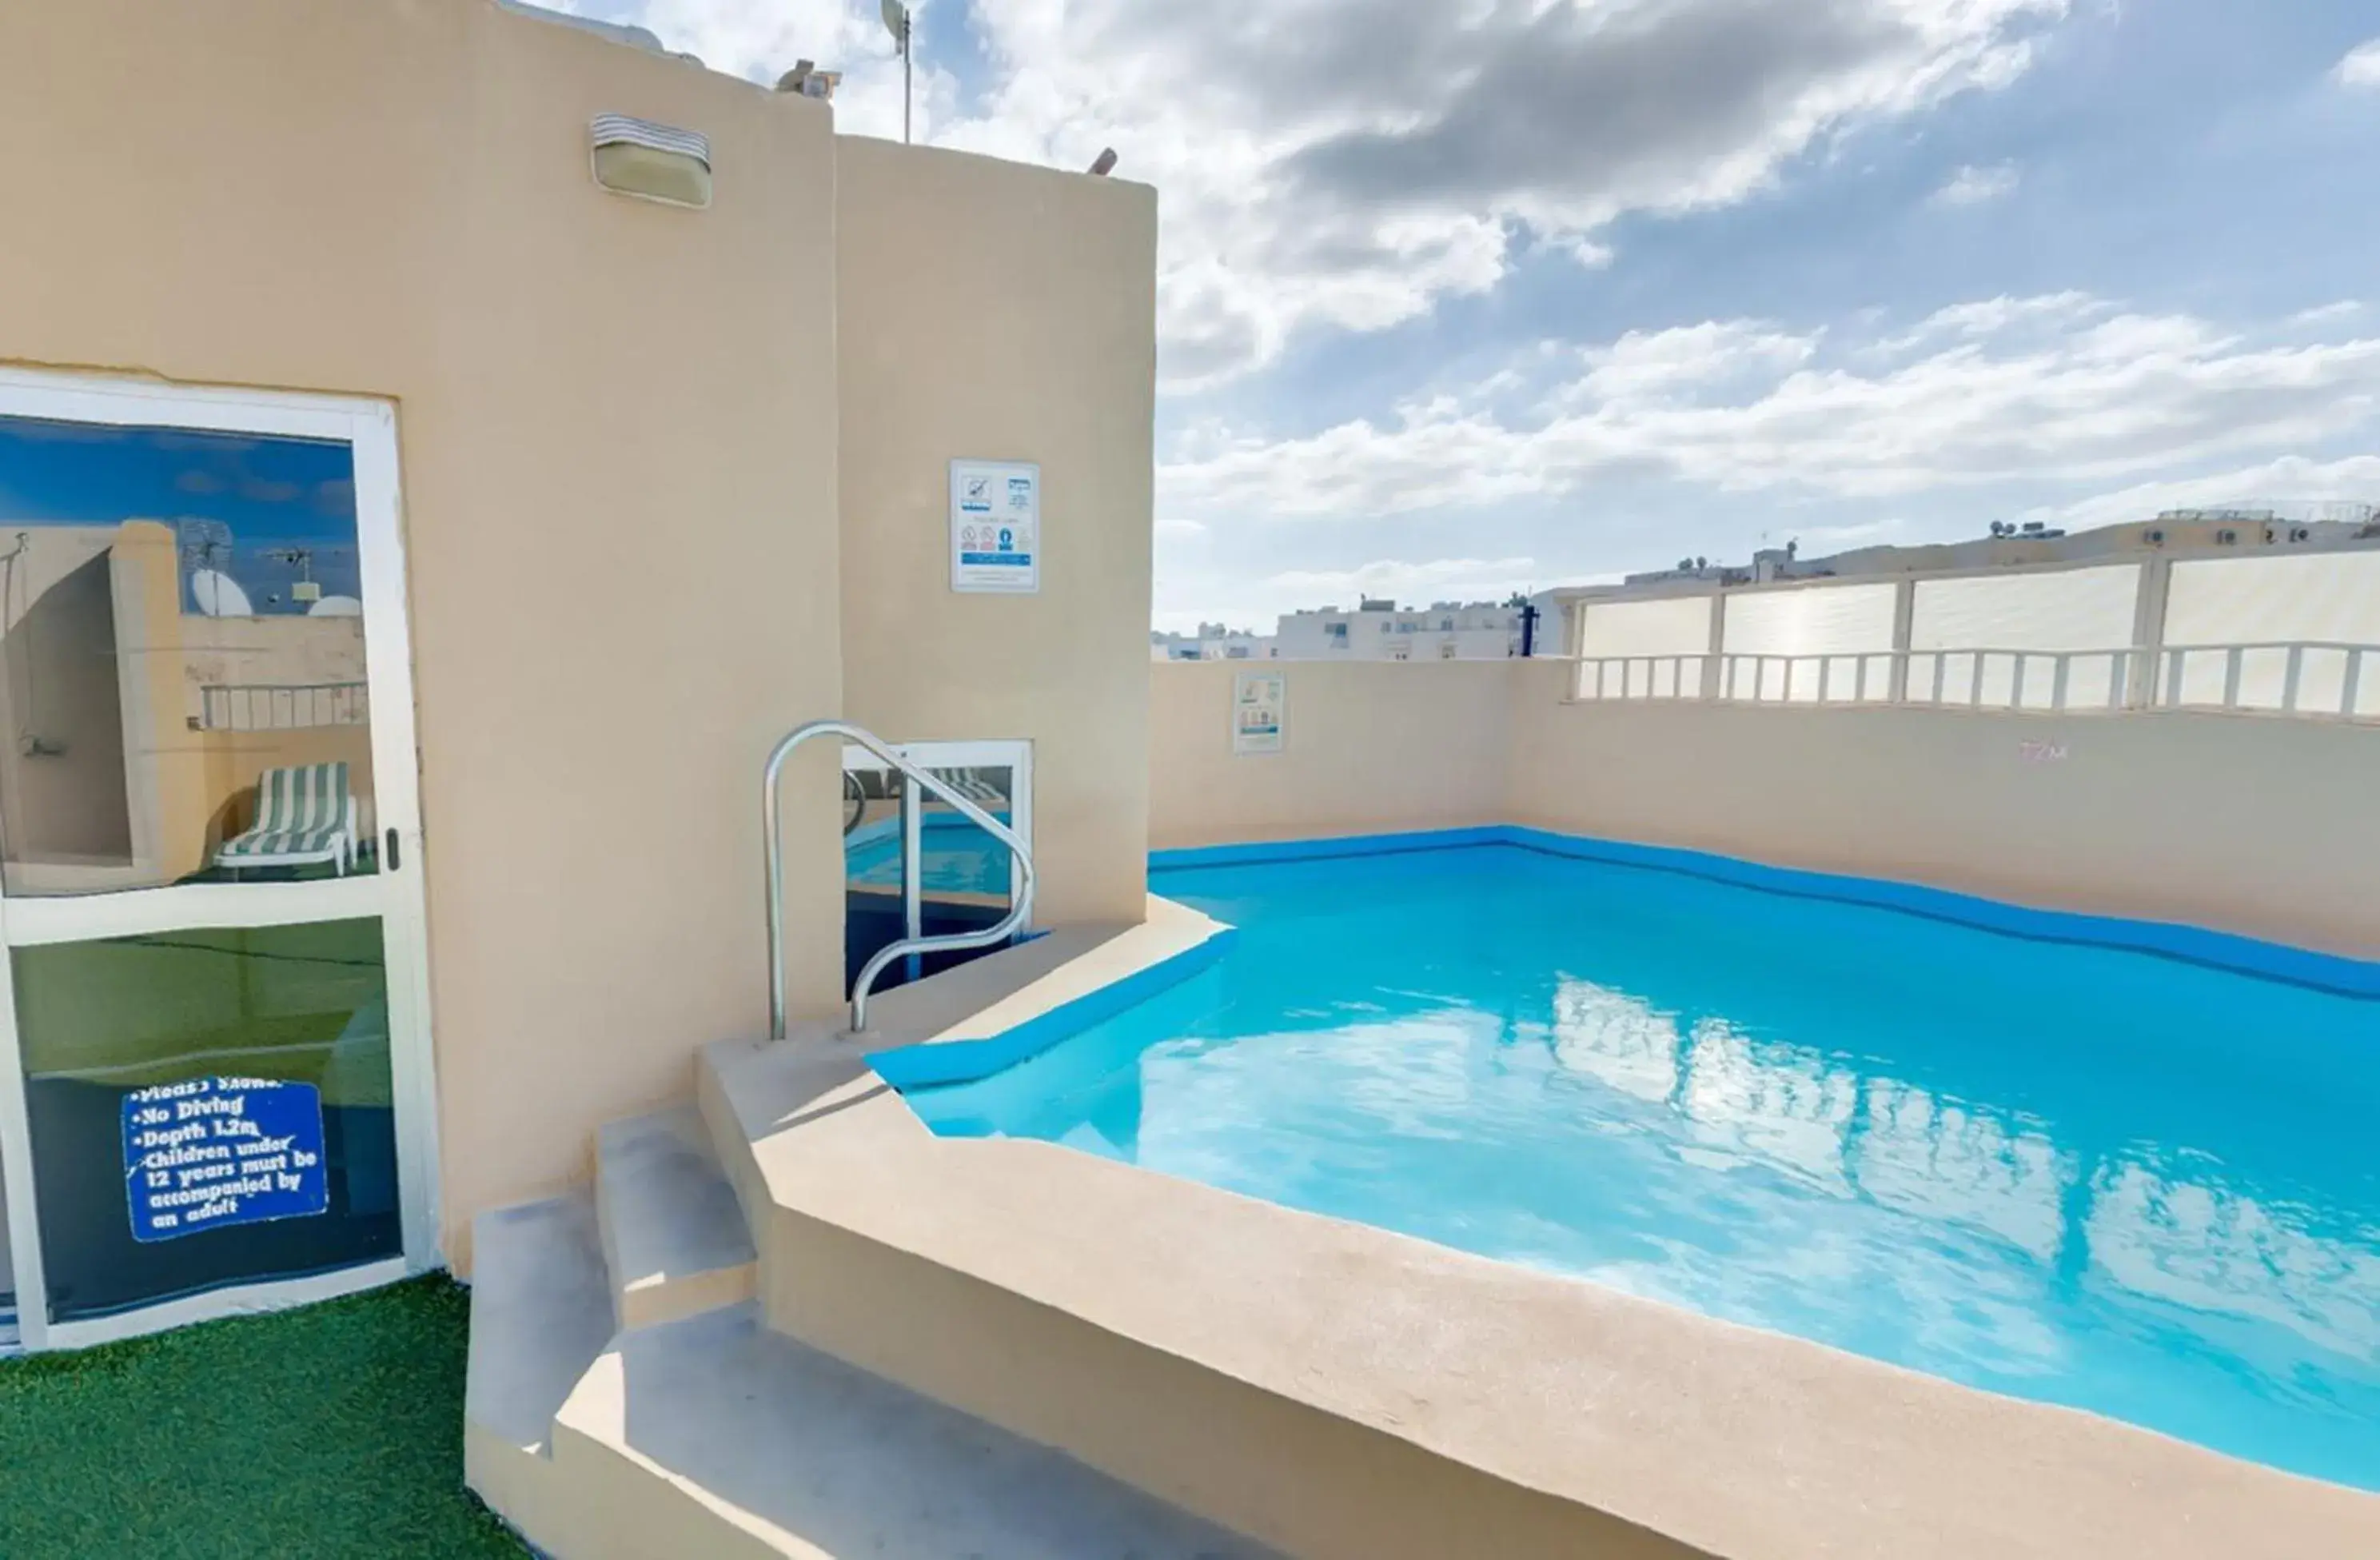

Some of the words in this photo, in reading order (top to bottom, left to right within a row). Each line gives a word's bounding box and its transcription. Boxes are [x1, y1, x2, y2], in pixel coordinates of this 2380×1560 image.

[142, 1107, 169, 1124] No
[177, 1095, 245, 1119] Diving
[143, 1123, 206, 1148] Depth
[213, 1119, 261, 1137] 1.2m
[146, 1145, 230, 1169] Children
[236, 1136, 291, 1156] under
[146, 1170, 170, 1188] 12
[177, 1163, 236, 1187] years
[241, 1154, 286, 1175] must
[293, 1150, 317, 1167] be
[149, 1175, 272, 1208] accompanied
[277, 1171, 301, 1191] by
[152, 1213, 177, 1228] an
[186, 1199, 238, 1222] adult
